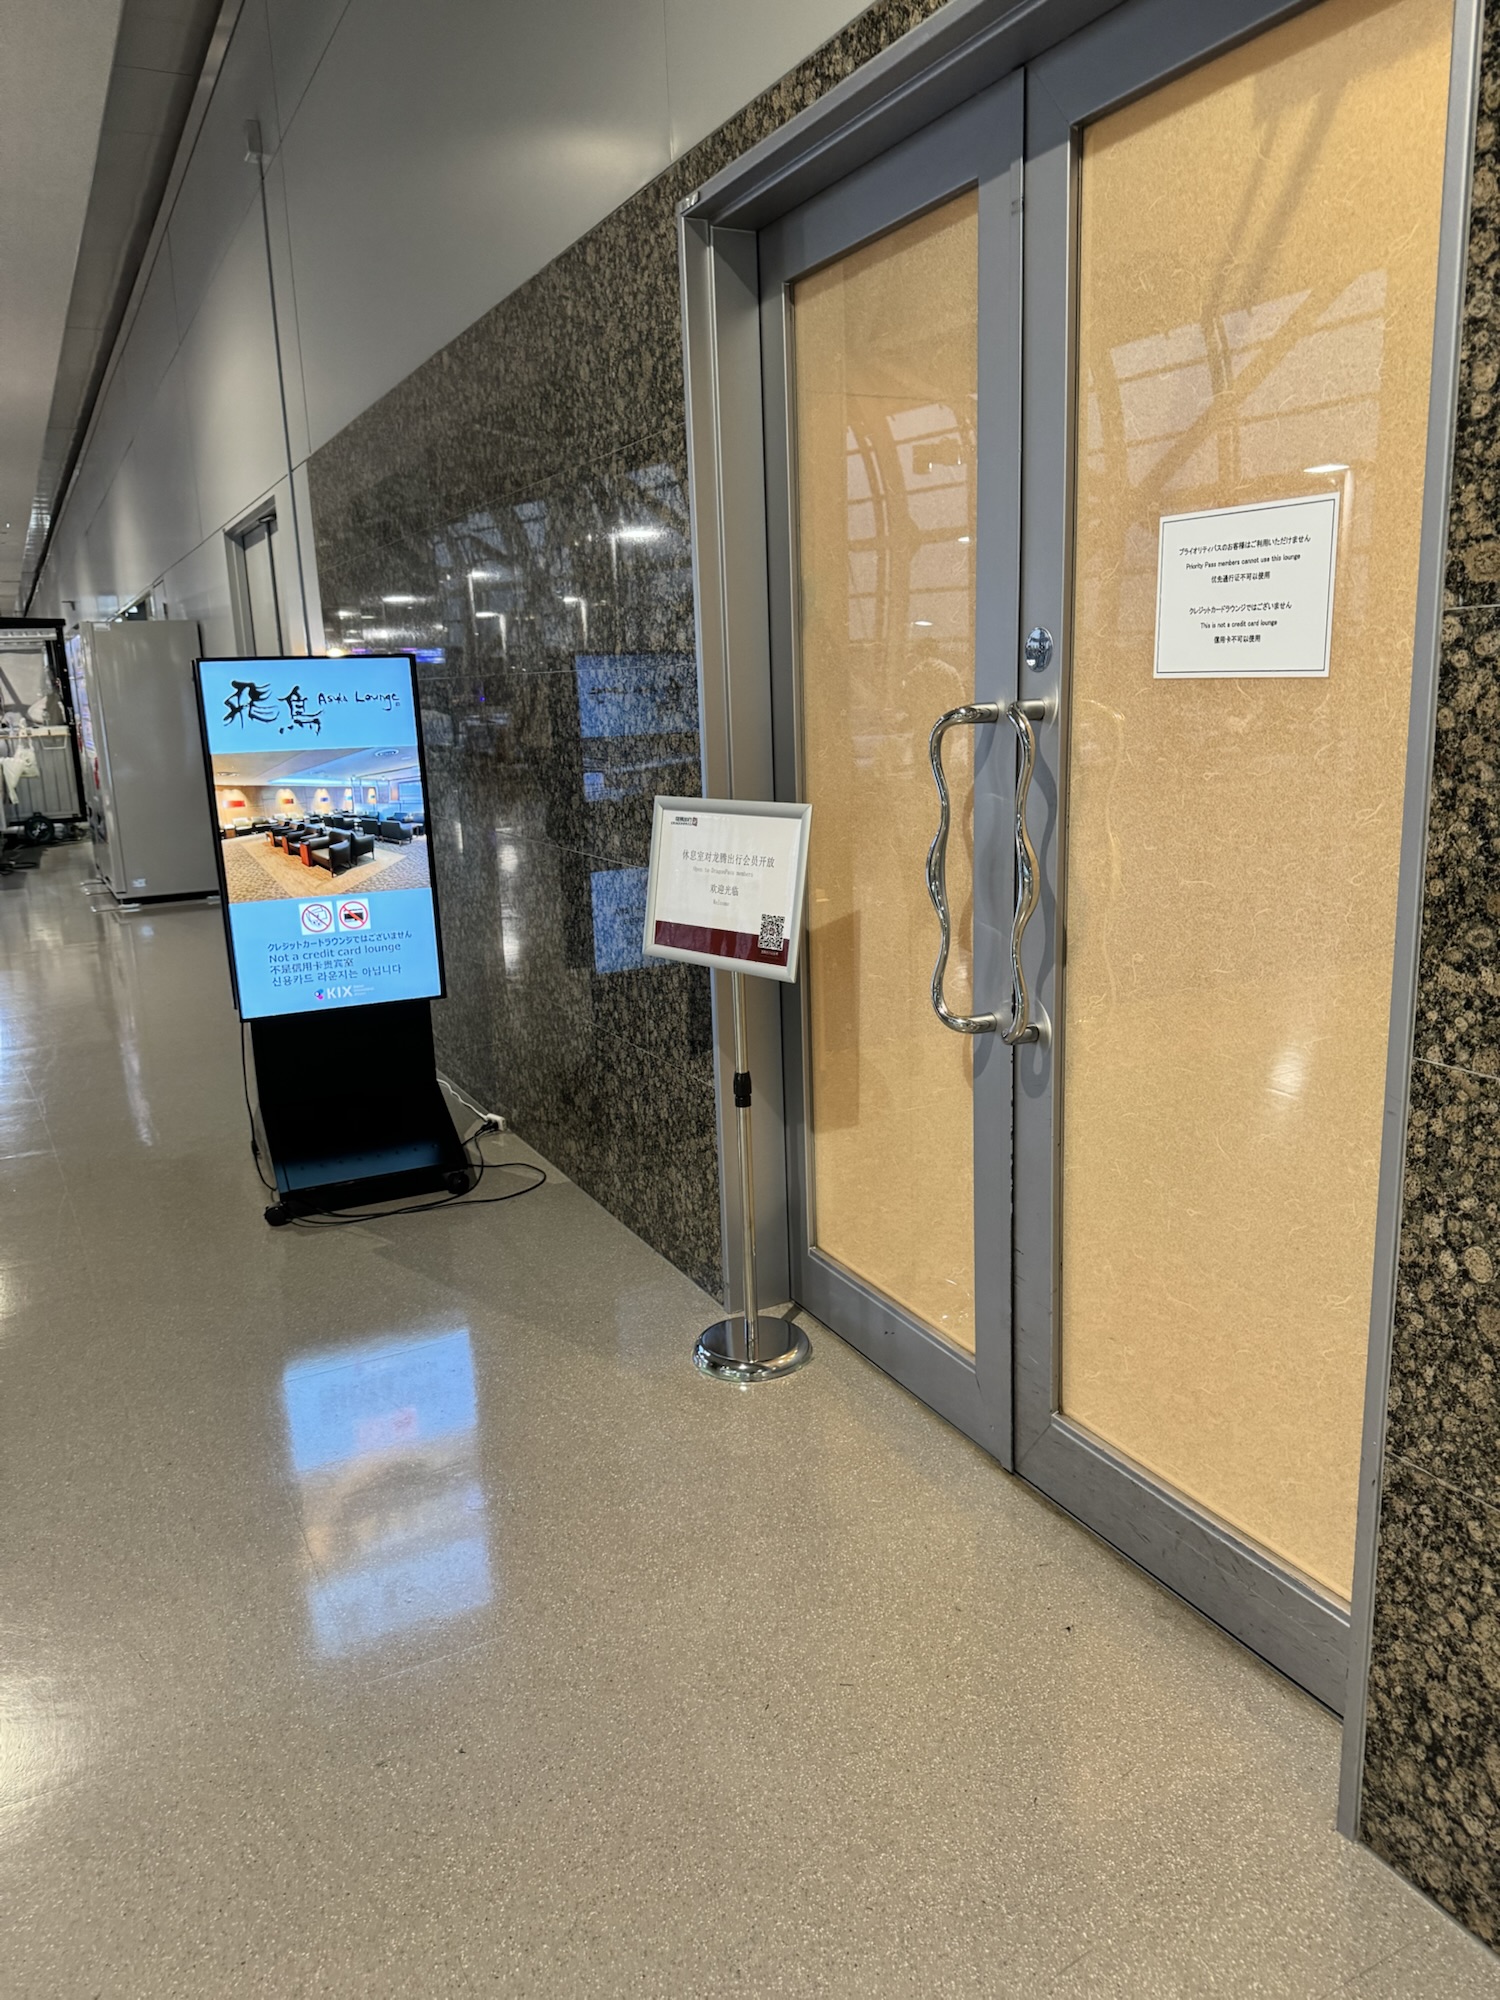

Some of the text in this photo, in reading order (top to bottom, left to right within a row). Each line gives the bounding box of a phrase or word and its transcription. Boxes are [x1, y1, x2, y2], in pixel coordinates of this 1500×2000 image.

[1186, 562, 1203, 571] Priority
[1204, 561, 1217, 569] Pass
[1218, 558, 1240, 568] members
[1241, 557, 1259, 565] cannot
[1271, 554, 1282, 562] this
[1283, 553, 1301, 562] lounge
[1231, 620, 1246, 628] credit
[1247, 619, 1259, 627] card
[1260, 619, 1278, 628] lounge
[355, 690, 400, 711] Lounge
[710, 883, 739, 897] 欢迎光临
[269, 942, 401, 964] Not a credit card lounge
[272, 963, 402, 987] 신용카드 라운지는 아닙니다
[326, 985, 353, 999] KIX
